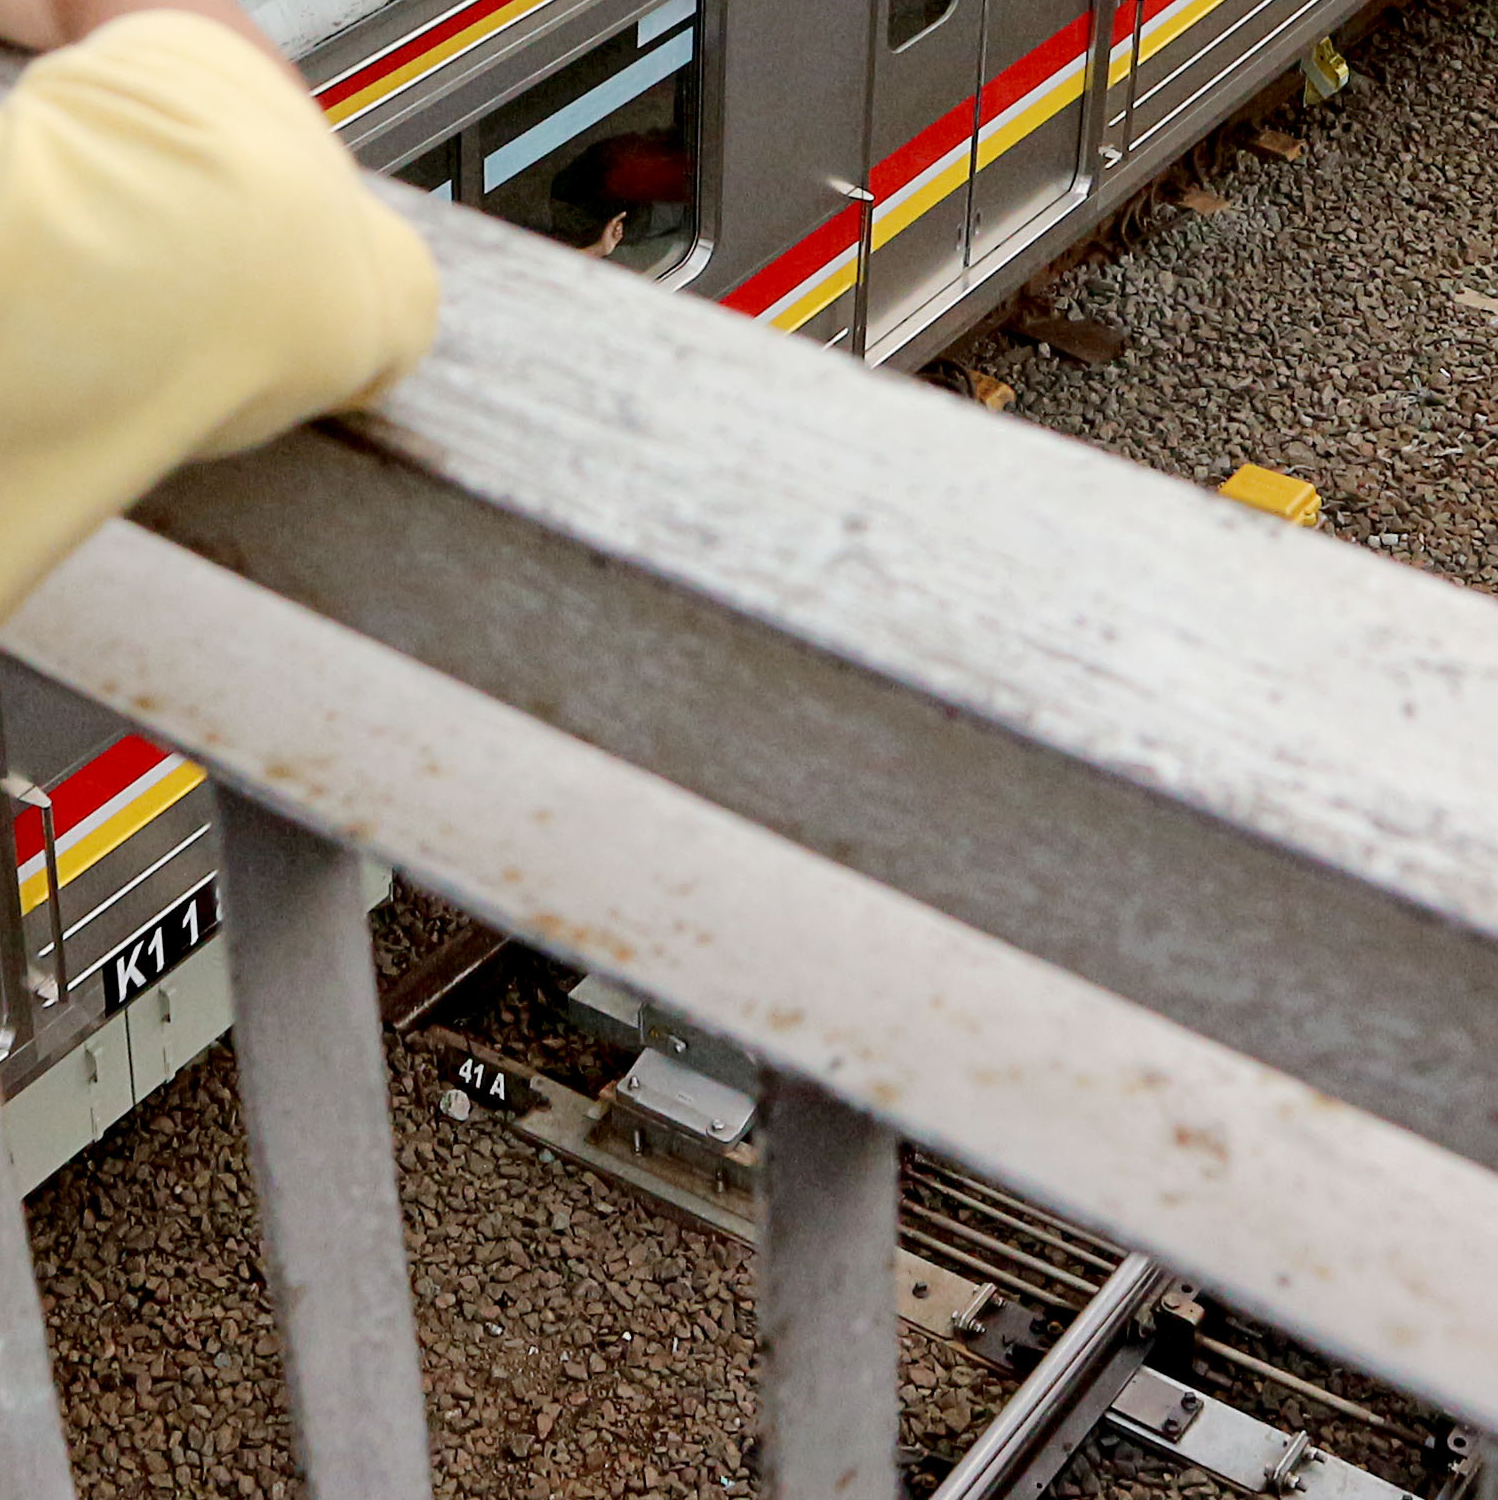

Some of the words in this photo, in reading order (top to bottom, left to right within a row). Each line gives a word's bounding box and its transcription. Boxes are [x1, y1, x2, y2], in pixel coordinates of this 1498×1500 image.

[116, 926, 165, 1003] K1
[458, 1058, 484, 1089] 41
[489, 1072, 505, 1100] A
